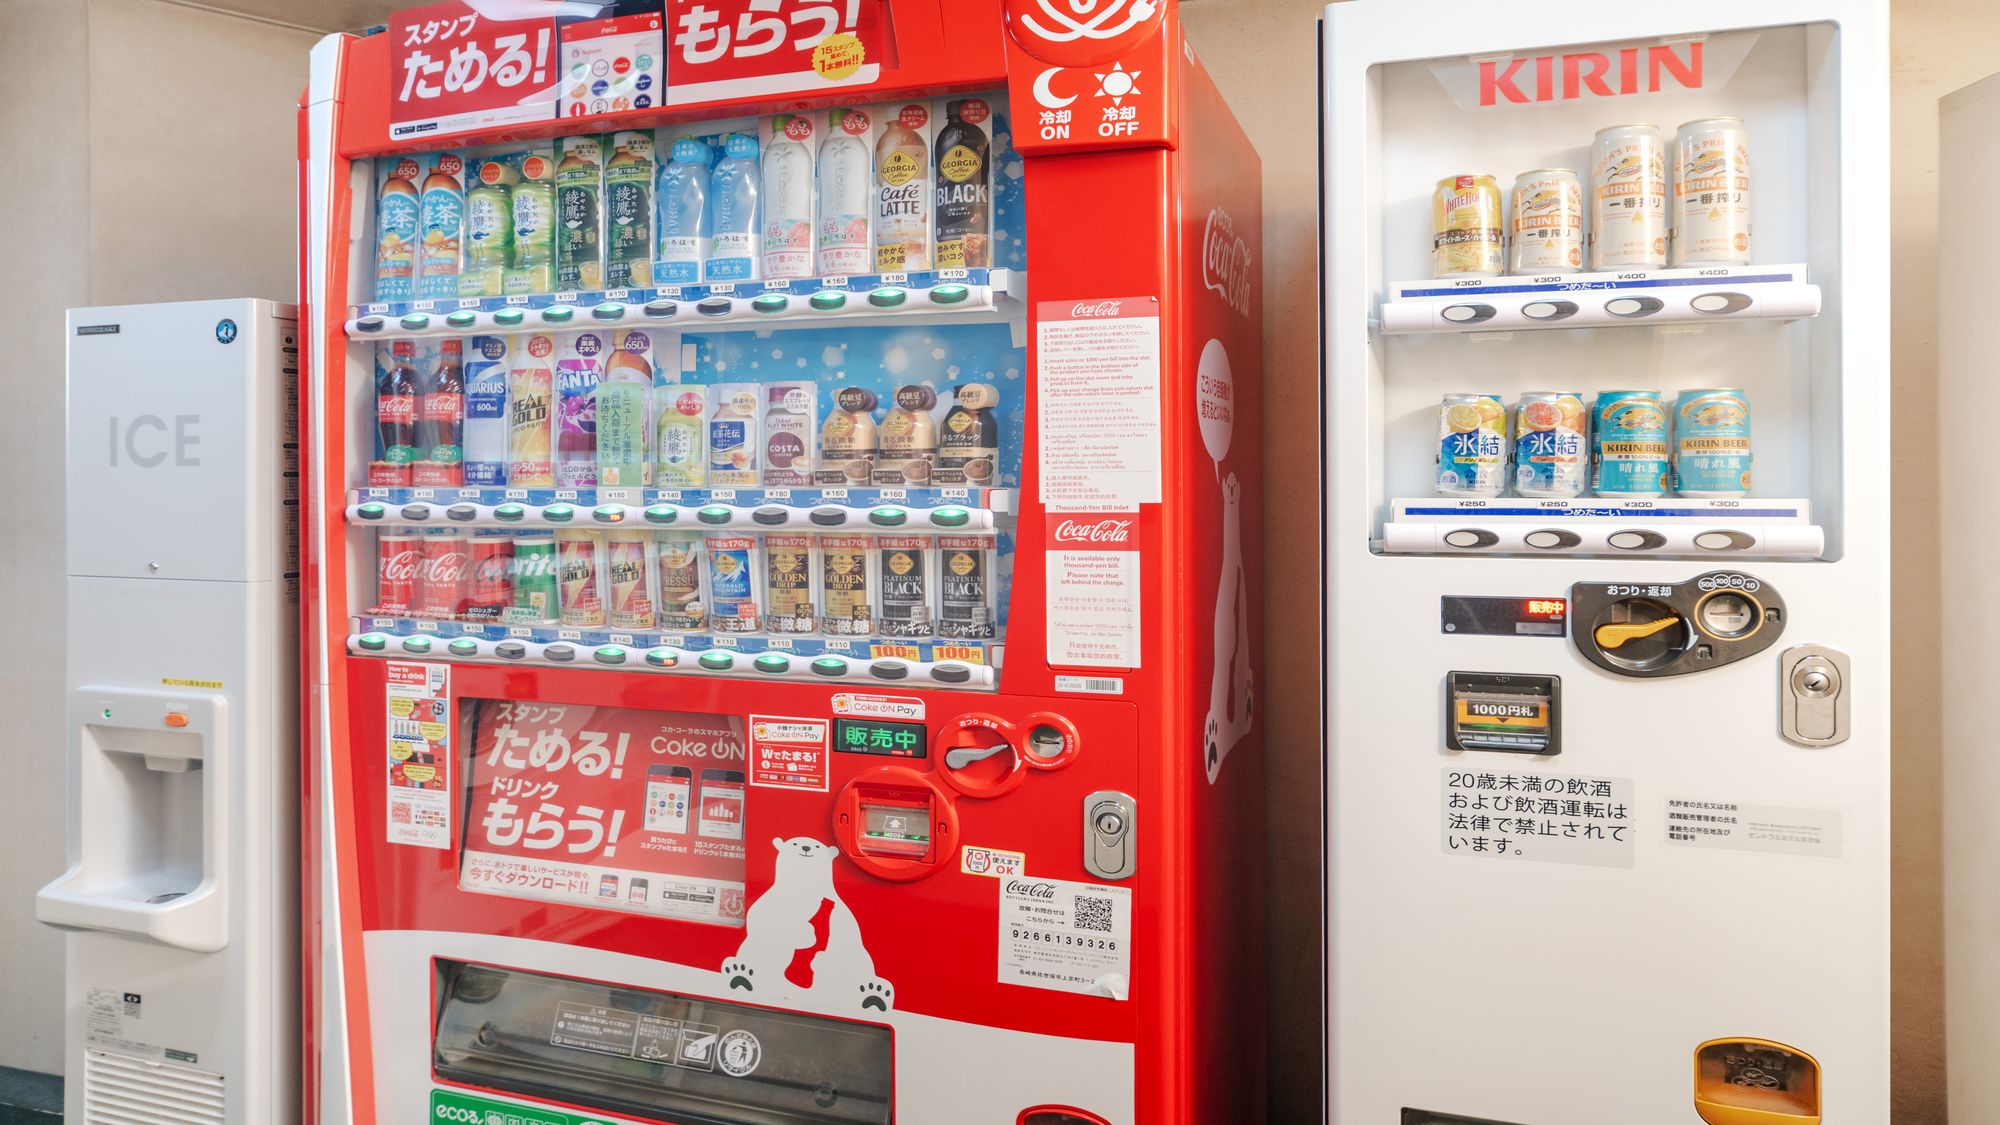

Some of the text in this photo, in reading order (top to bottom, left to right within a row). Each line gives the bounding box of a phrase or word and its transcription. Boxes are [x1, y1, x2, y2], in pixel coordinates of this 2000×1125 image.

[404, 11, 478, 47] スタンプ
[399, 27, 550, 103] ためる!
[1479, 42, 1704, 107] KIRIN
[1039, 109, 1071, 125] 冷却
[1103, 106, 1136, 122] 冷却
[787, 122, 810, 136] もも
[844, 116, 868, 130] もも
[1099, 121, 1138, 137] OFF
[1040, 125, 1069, 139] ON
[397, 167, 417, 176] 650
[440, 162, 460, 171] 650
[882, 165, 917, 173] GEORGIA
[942, 160, 978, 169] GEORGIA
[881, 184, 919, 202] Café
[937, 184, 988, 206] BLACK
[565, 190, 579, 220] 綾鷹
[616, 186, 631, 216] 綾鷹
[1444, 194, 1465, 215] WHITE
[881, 200, 920, 217] LATTE
[712, 265, 742, 275] 天然水
[1203, 208, 1251, 318] Coca-Cola
[661, 269, 689, 279] 天然水
[826, 277, 846, 285] ¥160
[885, 274, 905, 282] ¥180
[768, 280, 786, 288] ¥160
[608, 290, 626, 298] ¥170
[1072, 301, 1122, 317] Coca-Cola
[557, 369, 602, 390] FANTA
[840, 393, 862, 401] 高級豆
[899, 392, 921, 400] 高級豆
[960, 391, 981, 399] 高級豆
[512, 394, 545, 413] REAL
[841, 399, 861, 407] ブレンド
[513, 405, 547, 426] GOLD
[110, 414, 200, 468] ICE
[667, 427, 682, 455] 綾鷹
[1454, 433, 1499, 455] 氷結
[1530, 432, 1578, 455] 氷結
[1686, 439, 1747, 448] KIRIN BEER
[769, 445, 800, 453] COSTA
[1619, 463, 1659, 474] 晴れ風
[1695, 457, 1741, 469] 晴れ風
[1441, 473, 1456, 484] お酒
[1518, 469, 1533, 479] お酒
[608, 491, 626, 499] ¥150
[714, 490, 733, 498] ¥150
[1055, 520, 1133, 542] Coca-Cola
[611, 561, 636, 575] REAL
[562, 569, 589, 583] GOLD
[612, 570, 640, 584] GOLD
[770, 573, 806, 582] GOLDEN
[825, 574, 865, 582] GOLDEN
[1716, 577, 1729, 586] 100
[1731, 577, 1742, 586] 50
[884, 582, 923, 595] BLACK
[944, 582, 984, 595] BLACK
[1606, 585, 1672, 597] おつり・返却
[1700, 580, 1715, 589] 500
[1746, 581, 1756, 590] 10
[1528, 600, 1564, 614] 販売中
[726, 617, 757, 631] 王道
[781, 618, 813, 632] 微糖
[837, 619, 870, 633] 微糖
[892, 622, 931, 635] シャキッと
[953, 623, 991, 636] シャキッと
[873, 645, 917, 658] 100円
[935, 647, 980, 659] 100円
[389, 672, 401, 680] buy
[496, 703, 567, 724] スタンプ
[854, 702, 917, 716] Coke ON Pay
[1472, 703, 1534, 717] 1000円札
[959, 718, 998, 729] おつり・返却
[661, 726, 737, 738] コカ・コーラのスマホアプリ
[771, 731, 791, 739] Coke
[804, 732, 819, 741] Pay
[845, 727, 917, 750] 販売中
[487, 723, 630, 779] ためる!
[651, 735, 745, 760] Coke ON
[761, 746, 817, 763] Wでたまる!
[491, 777, 560, 800] ドリンク
[1449, 773, 1612, 797] 20歳未満の飲酒
[1449, 792, 1627, 820] および飲酒運転は
[1669, 800, 1738, 811] 免許者の氏名又は名称
[1669, 812, 1738, 824] 酒類販売管理者の氏名
[482, 798, 625, 858] もらう!
[1448, 813, 1627, 842] 法律で禁止されて
[1669, 825, 1731, 836] 連絡先の所在地及び
[1669, 833, 1696, 841] 電話番号
[1449, 835, 1522, 855] います。
[992, 857, 1020, 867] 使えます
[996, 865, 1014, 876] OK
[470, 866, 588, 894] 今すぐダウンロード!!
[1006, 880, 1057, 899] Coca-Cola
[1019, 904, 1065, 916] 故障・お問合せは
[1026, 916, 1055, 925] こちらから
[1012, 929, 1116, 951] 9266139326
